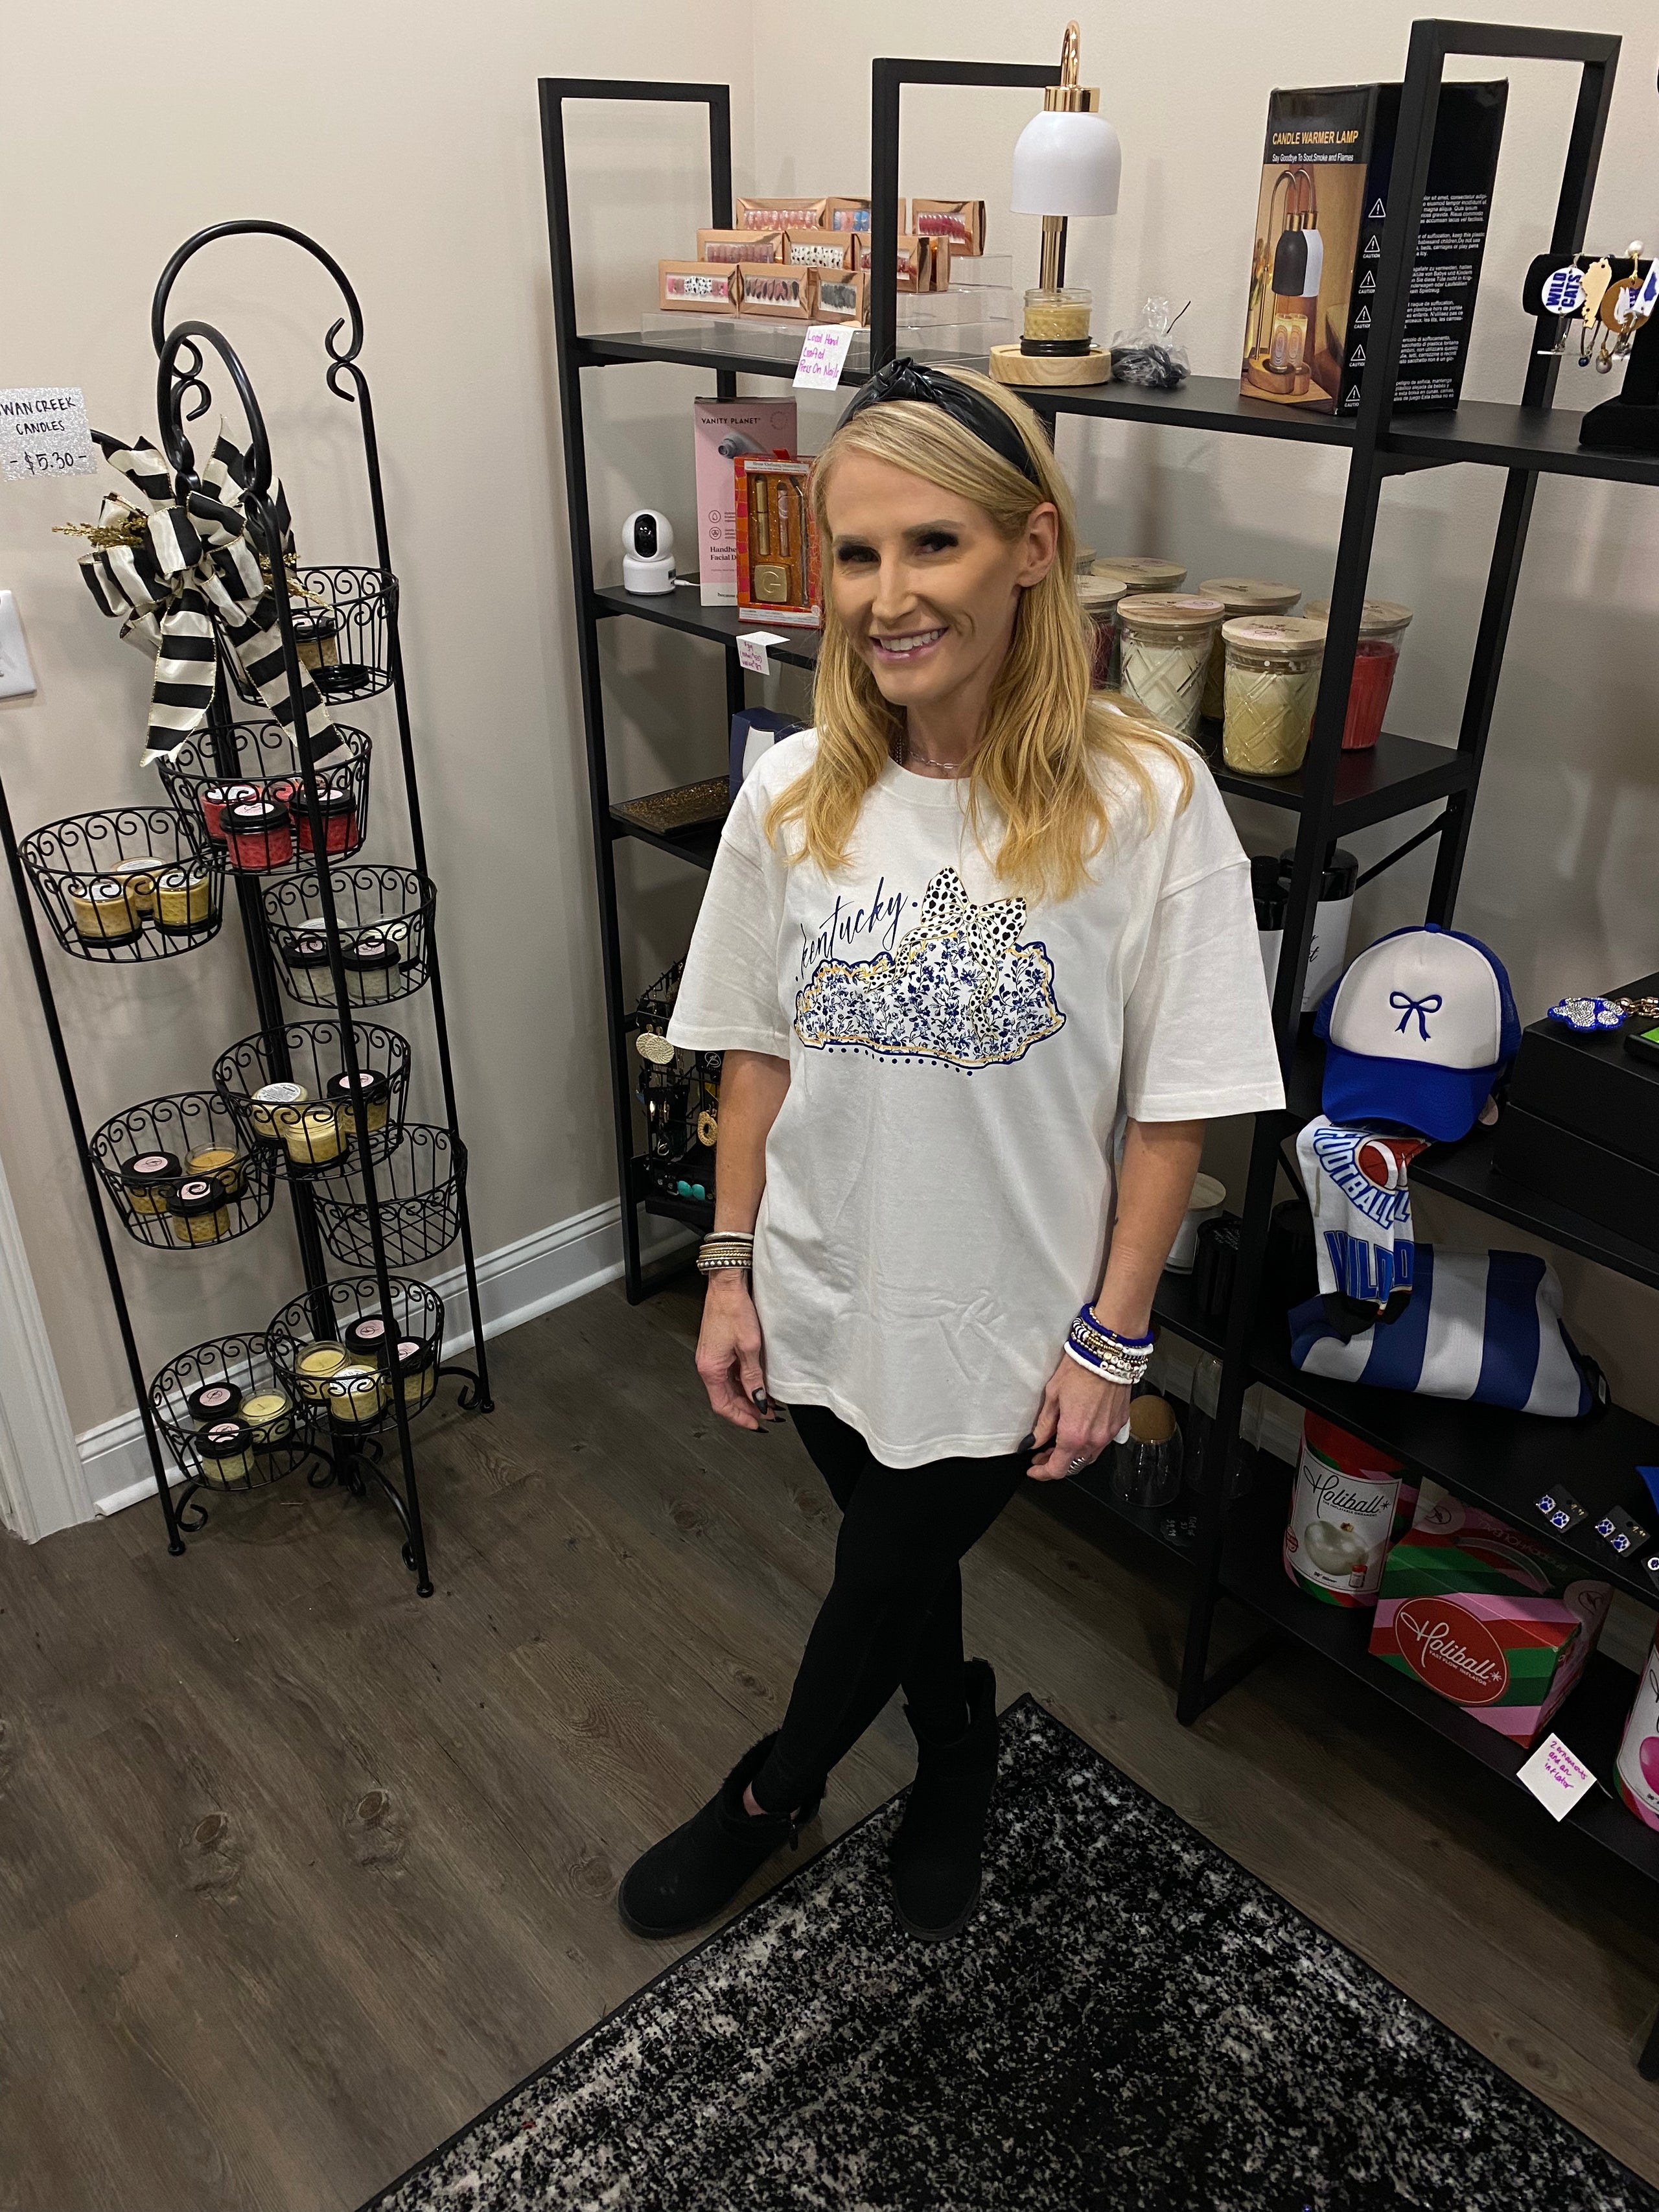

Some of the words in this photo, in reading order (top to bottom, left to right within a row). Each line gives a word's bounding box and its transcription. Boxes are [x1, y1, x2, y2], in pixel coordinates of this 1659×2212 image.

[1273, 132, 1301, 145] CANDLE
[1302, 131, 1335, 144] WARMER
[1336, 130, 1358, 143] LAMP
[1280, 154, 1297, 163] Goodbye
[1338, 153, 1353, 161] Flames
[1546, 273, 1567, 306] WILD
[1561, 274, 1582, 307] CATS
[824, 334, 839, 345] Hand
[798, 359, 811, 373] Press
[813, 363, 821, 373] On
[824, 362, 839, 378] Nails
[0, 402, 33, 415] WAN
[36, 397, 76, 412] CREEK
[16, 421, 65, 435] CANDLES
[25, 452, 73, 474] $5.30
[1303, 1465, 1380, 1519] Holiball
[1400, 1612, 1496, 1680] Holiball
[1429, 1650, 1443, 1660] FAST
[1443, 1658, 1457, 1669] FLOW
[1459, 1668, 1487, 1686] INFLATOR
[1549, 1752, 1561, 1764] and
[1560, 1765, 1572, 1776] an
